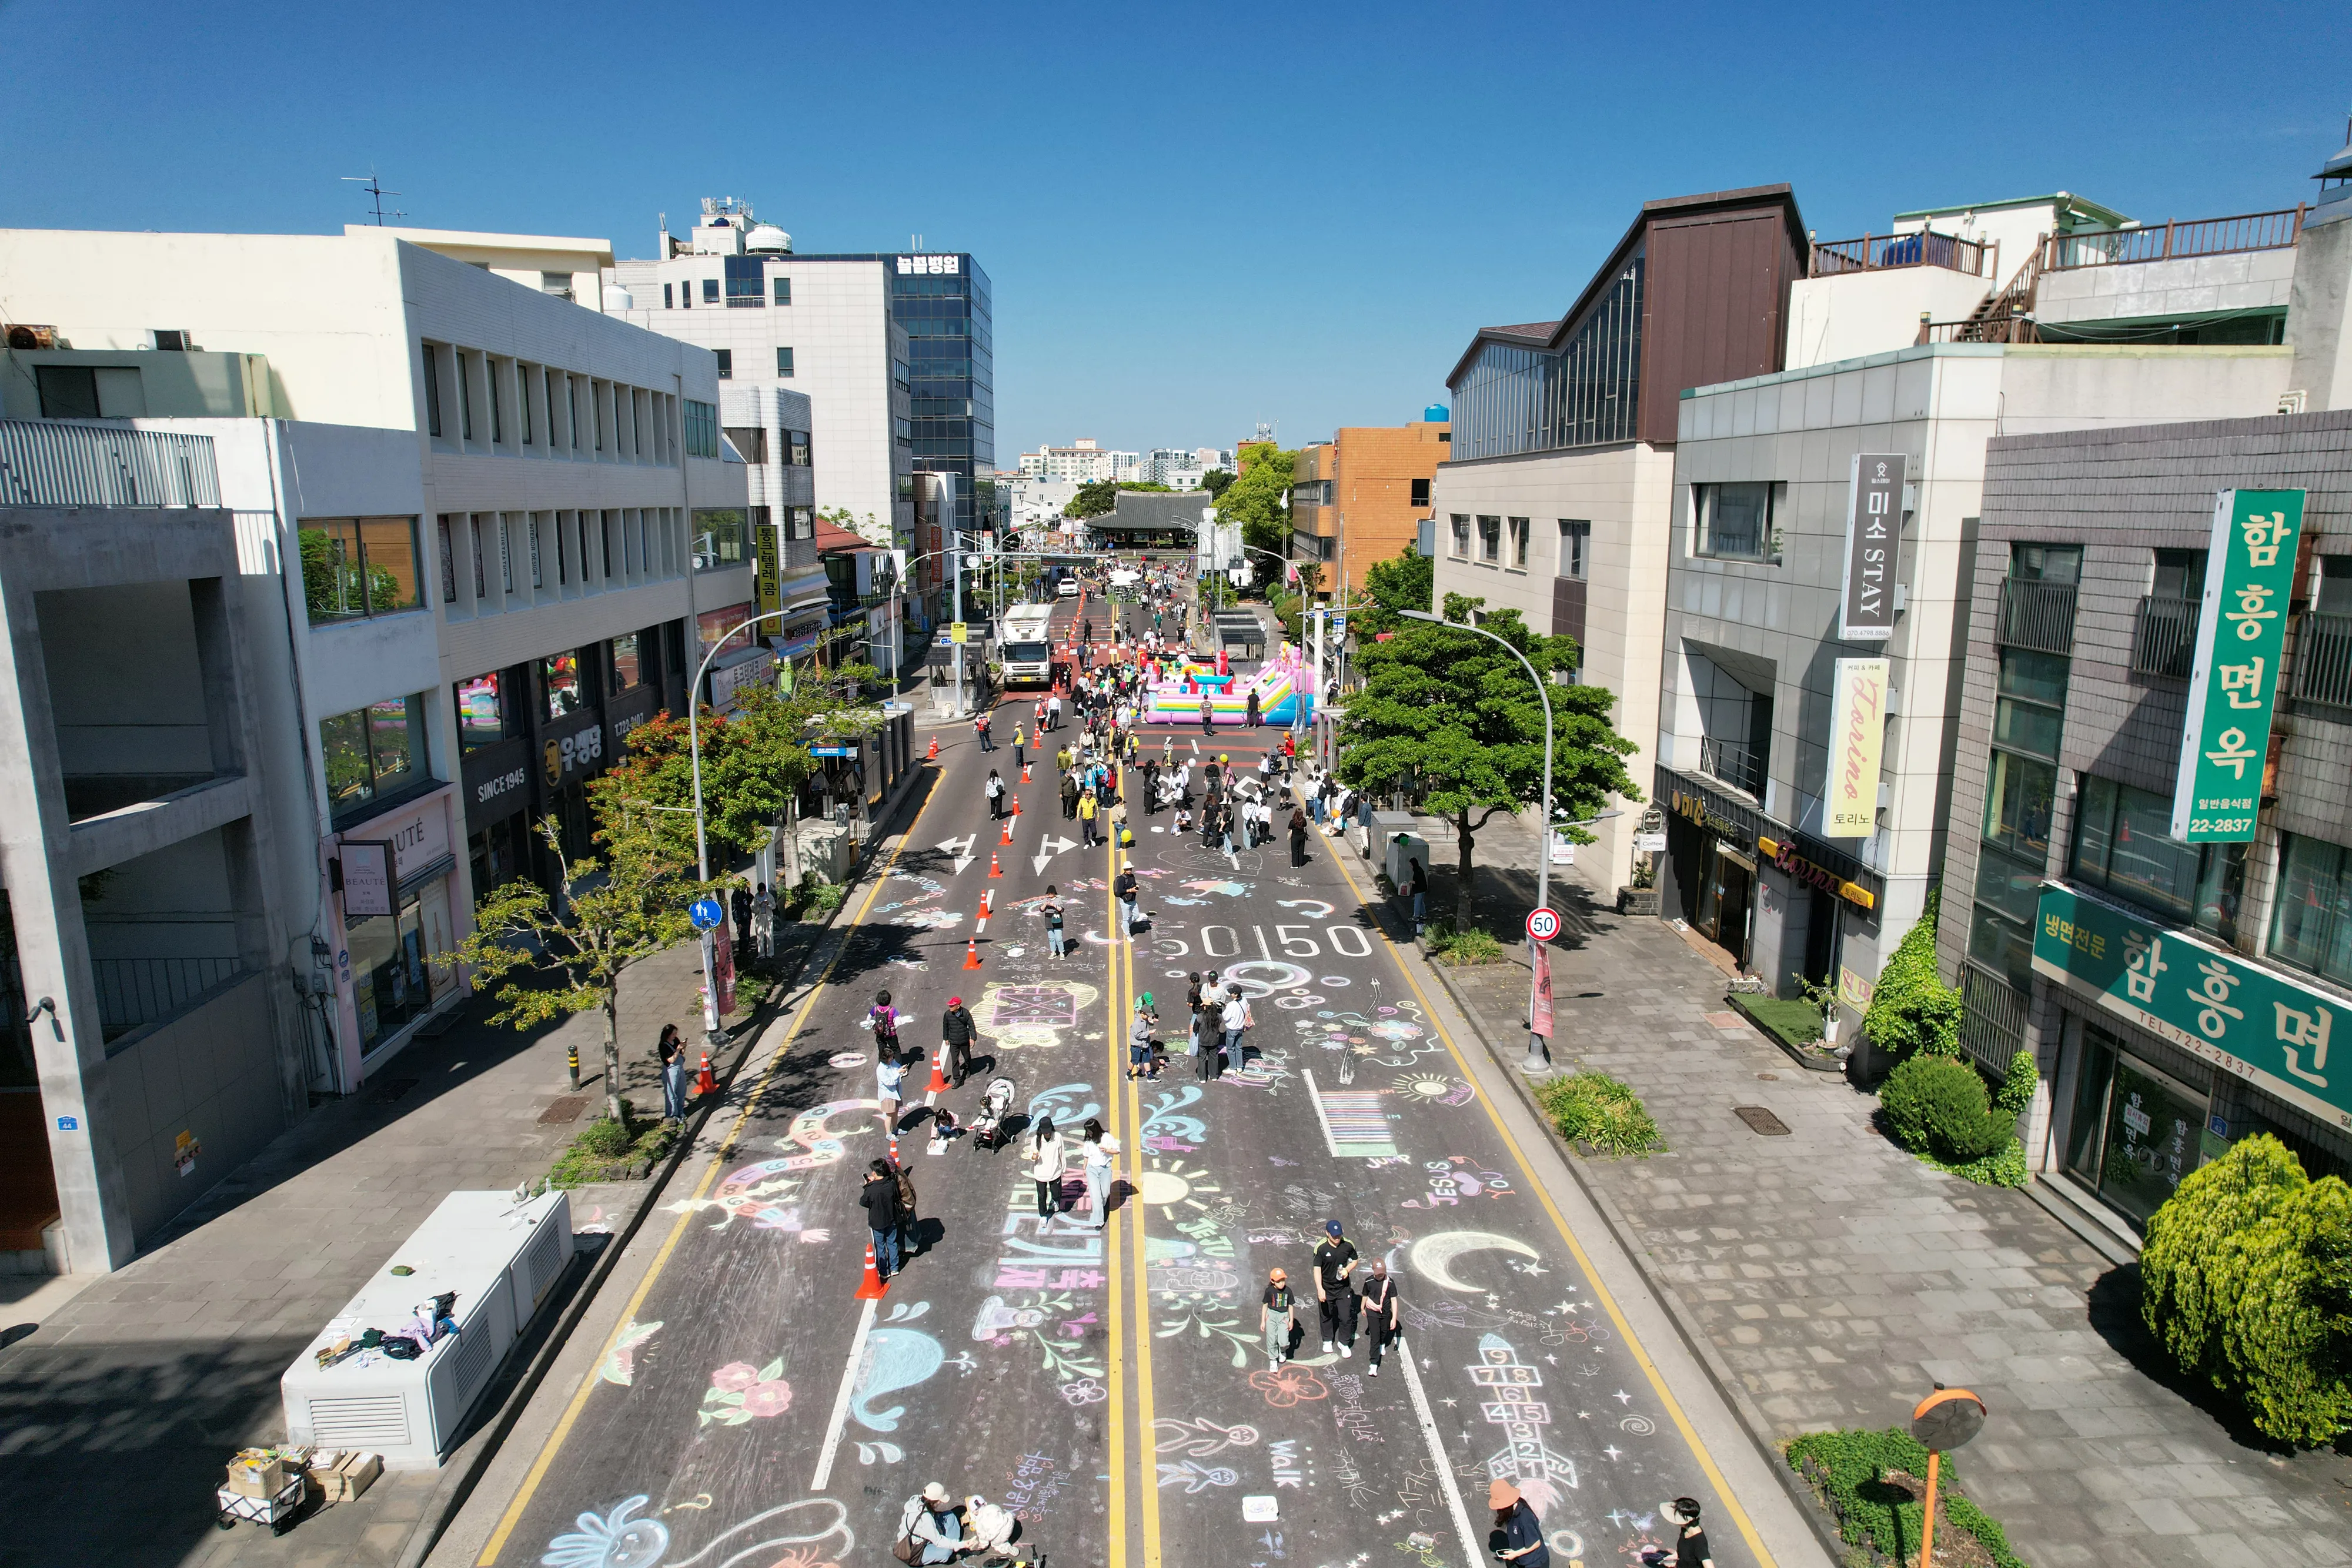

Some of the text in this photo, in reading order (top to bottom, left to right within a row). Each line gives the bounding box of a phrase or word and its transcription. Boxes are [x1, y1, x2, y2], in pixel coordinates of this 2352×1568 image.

[1860, 492, 1889, 617] 미소 STAY
[1847, 629, 1889, 637] 070.4798.8886
[2205, 511, 2292, 780] 함흥면옥
[1844, 677, 1879, 799] Torino
[560, 724, 602, 772] 우생당
[477, 767, 525, 803] SINCE 1945
[2199, 798, 2252, 810] 일반음식점
[1682, 795, 1735, 837] 미소 게스트하우스
[1835, 814, 1870, 825] 토리노
[2190, 818, 2252, 833] 22-2837
[1775, 840, 1835, 893] Torino
[346, 877, 386, 885] BEAUTÉ
[1845, 887, 1862, 902] 토리노
[1534, 917, 1553, 932] 50
[1151, 925, 1373, 957] 50 50
[2046, 913, 2106, 961] 냉면전문
[2121, 929, 2333, 1089] 함흥면
[2139, 1011, 2257, 1079] TEL.722-2837
[1367, 1154, 1411, 1169] JUMP
[1423, 1161, 1516, 1207] JESUS YOU
[1176, 1217, 1235, 1258] JEJU
[993, 1267, 1107, 1289] 축제
[1491, 1350, 1507, 1364] 9
[1479, 1369, 1495, 1382] 7
[1514, 1369, 1530, 1383] 8
[1504, 1388, 1521, 1402] 6
[1490, 1404, 1512, 1419] 4
[1524, 1405, 1543, 1420] 5
[1513, 1422, 1533, 1438] 3
[1518, 1443, 1538, 1459] 2
[1269, 1440, 1301, 1488] Walk
[1525, 1459, 1537, 1477] 1
